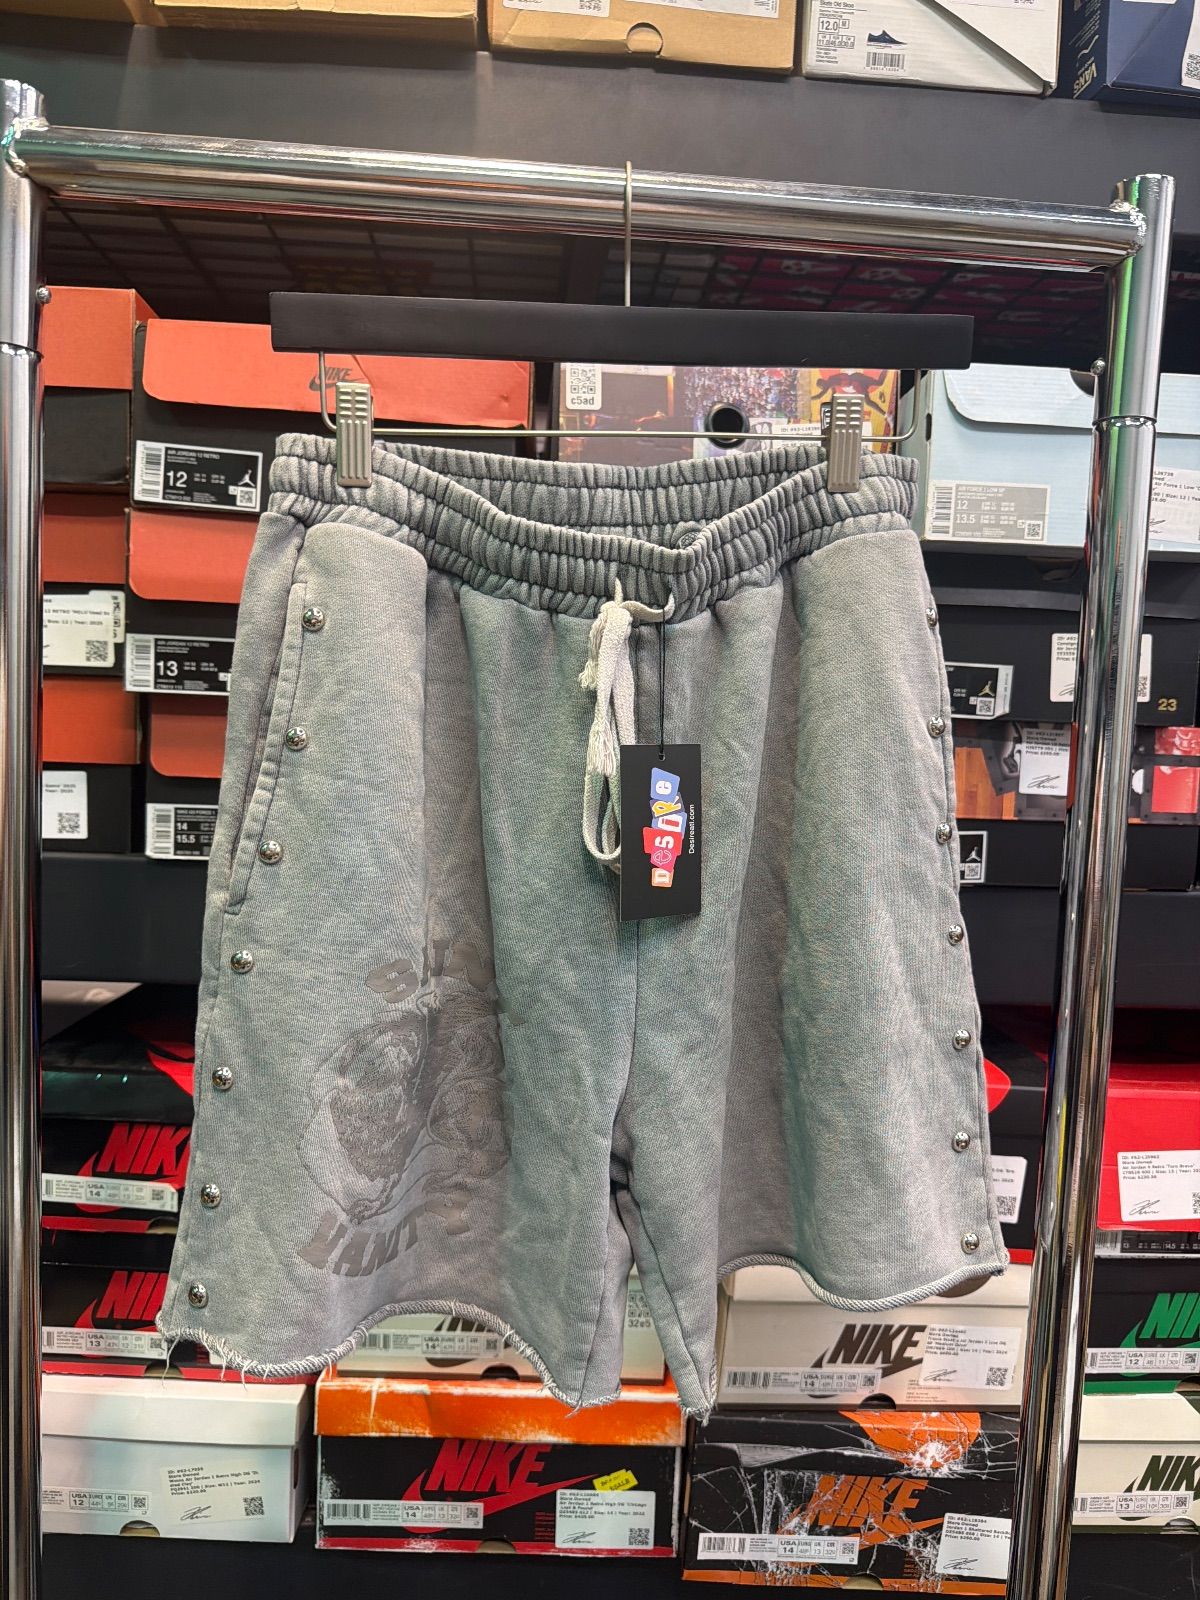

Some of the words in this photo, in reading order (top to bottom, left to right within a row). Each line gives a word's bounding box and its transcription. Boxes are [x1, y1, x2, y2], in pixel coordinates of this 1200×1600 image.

[820, 20, 838, 31] 12.0
[571, 396, 595, 405] c5ad
[166, 470, 188, 488] 12
[956, 500, 969, 510] 12
[956, 514, 976, 524] 13.5
[156, 660, 179, 677] 13
[1157, 698, 1178, 712] 23
[176, 822, 188, 831] 14
[176, 834, 196, 844] 15.5
[96, 1123, 192, 1175] NIK
[96, 1271, 169, 1320] NI
[827, 1324, 927, 1365] NIKE
[804, 1380, 815, 1388] 14
[425, 1439, 551, 1492] NIKE
[1136, 1455, 1200, 1491] NIK
[810, 1475, 929, 1531] NIKE
[782, 1546, 794, 1554] 14
